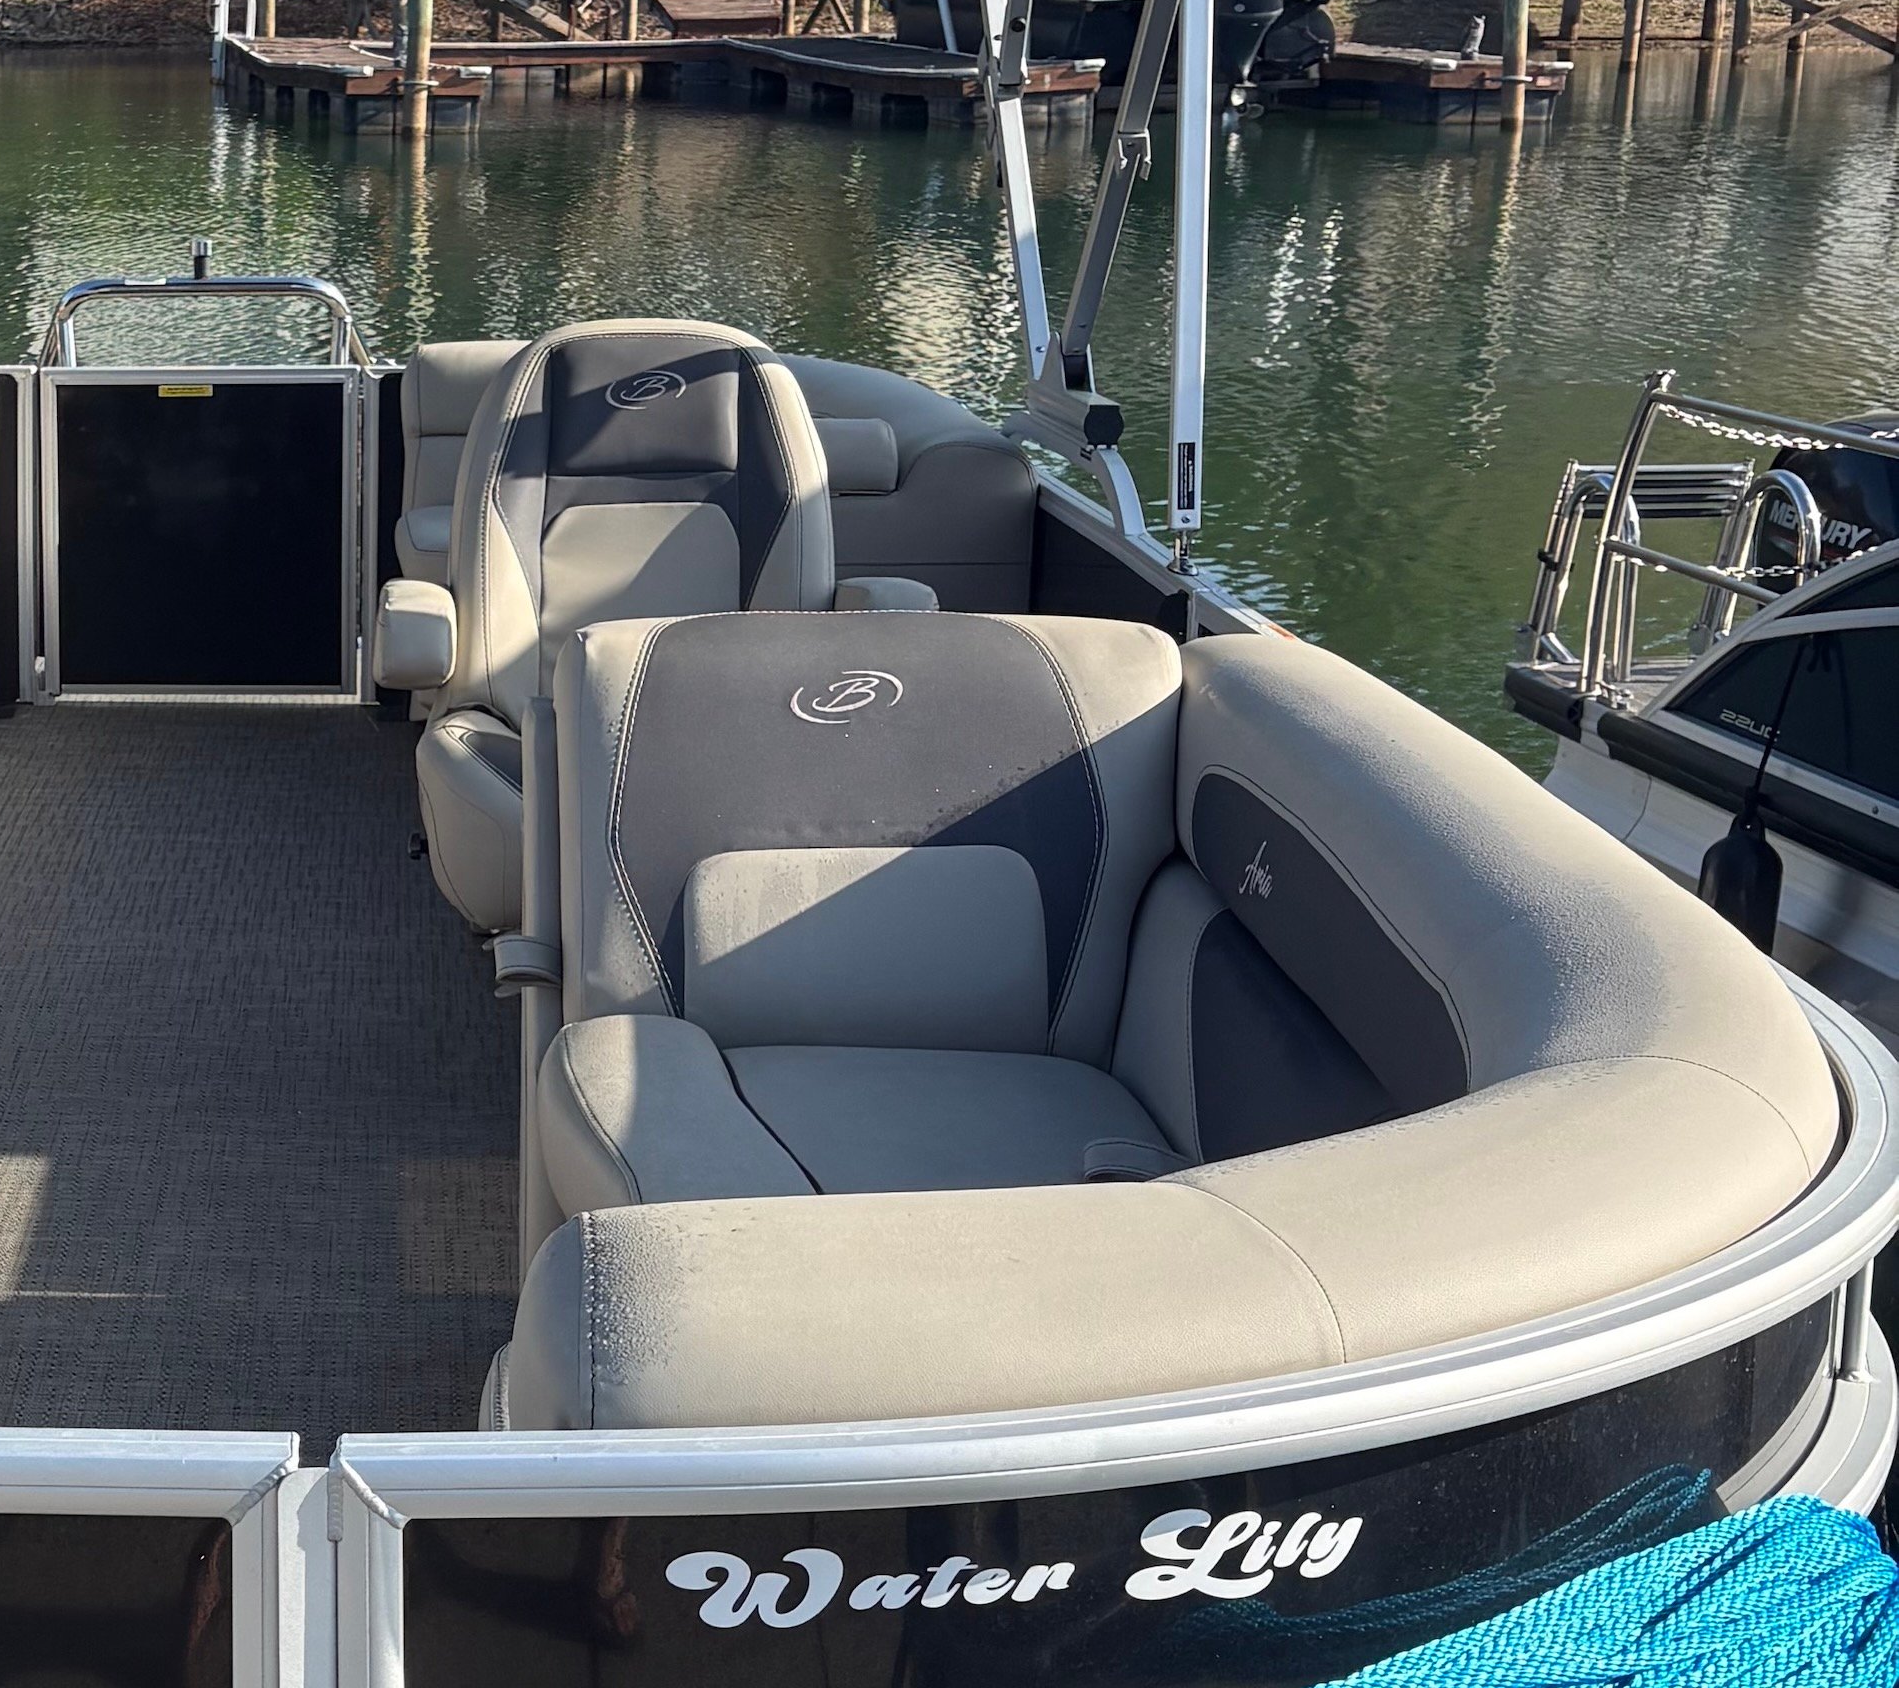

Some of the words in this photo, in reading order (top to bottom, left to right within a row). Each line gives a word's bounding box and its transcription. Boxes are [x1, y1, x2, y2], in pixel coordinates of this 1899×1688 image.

[1769, 499, 1872, 550] MEURY
[665, 1548, 1075, 1628] Water
[1125, 1509, 1363, 1601] Lily
